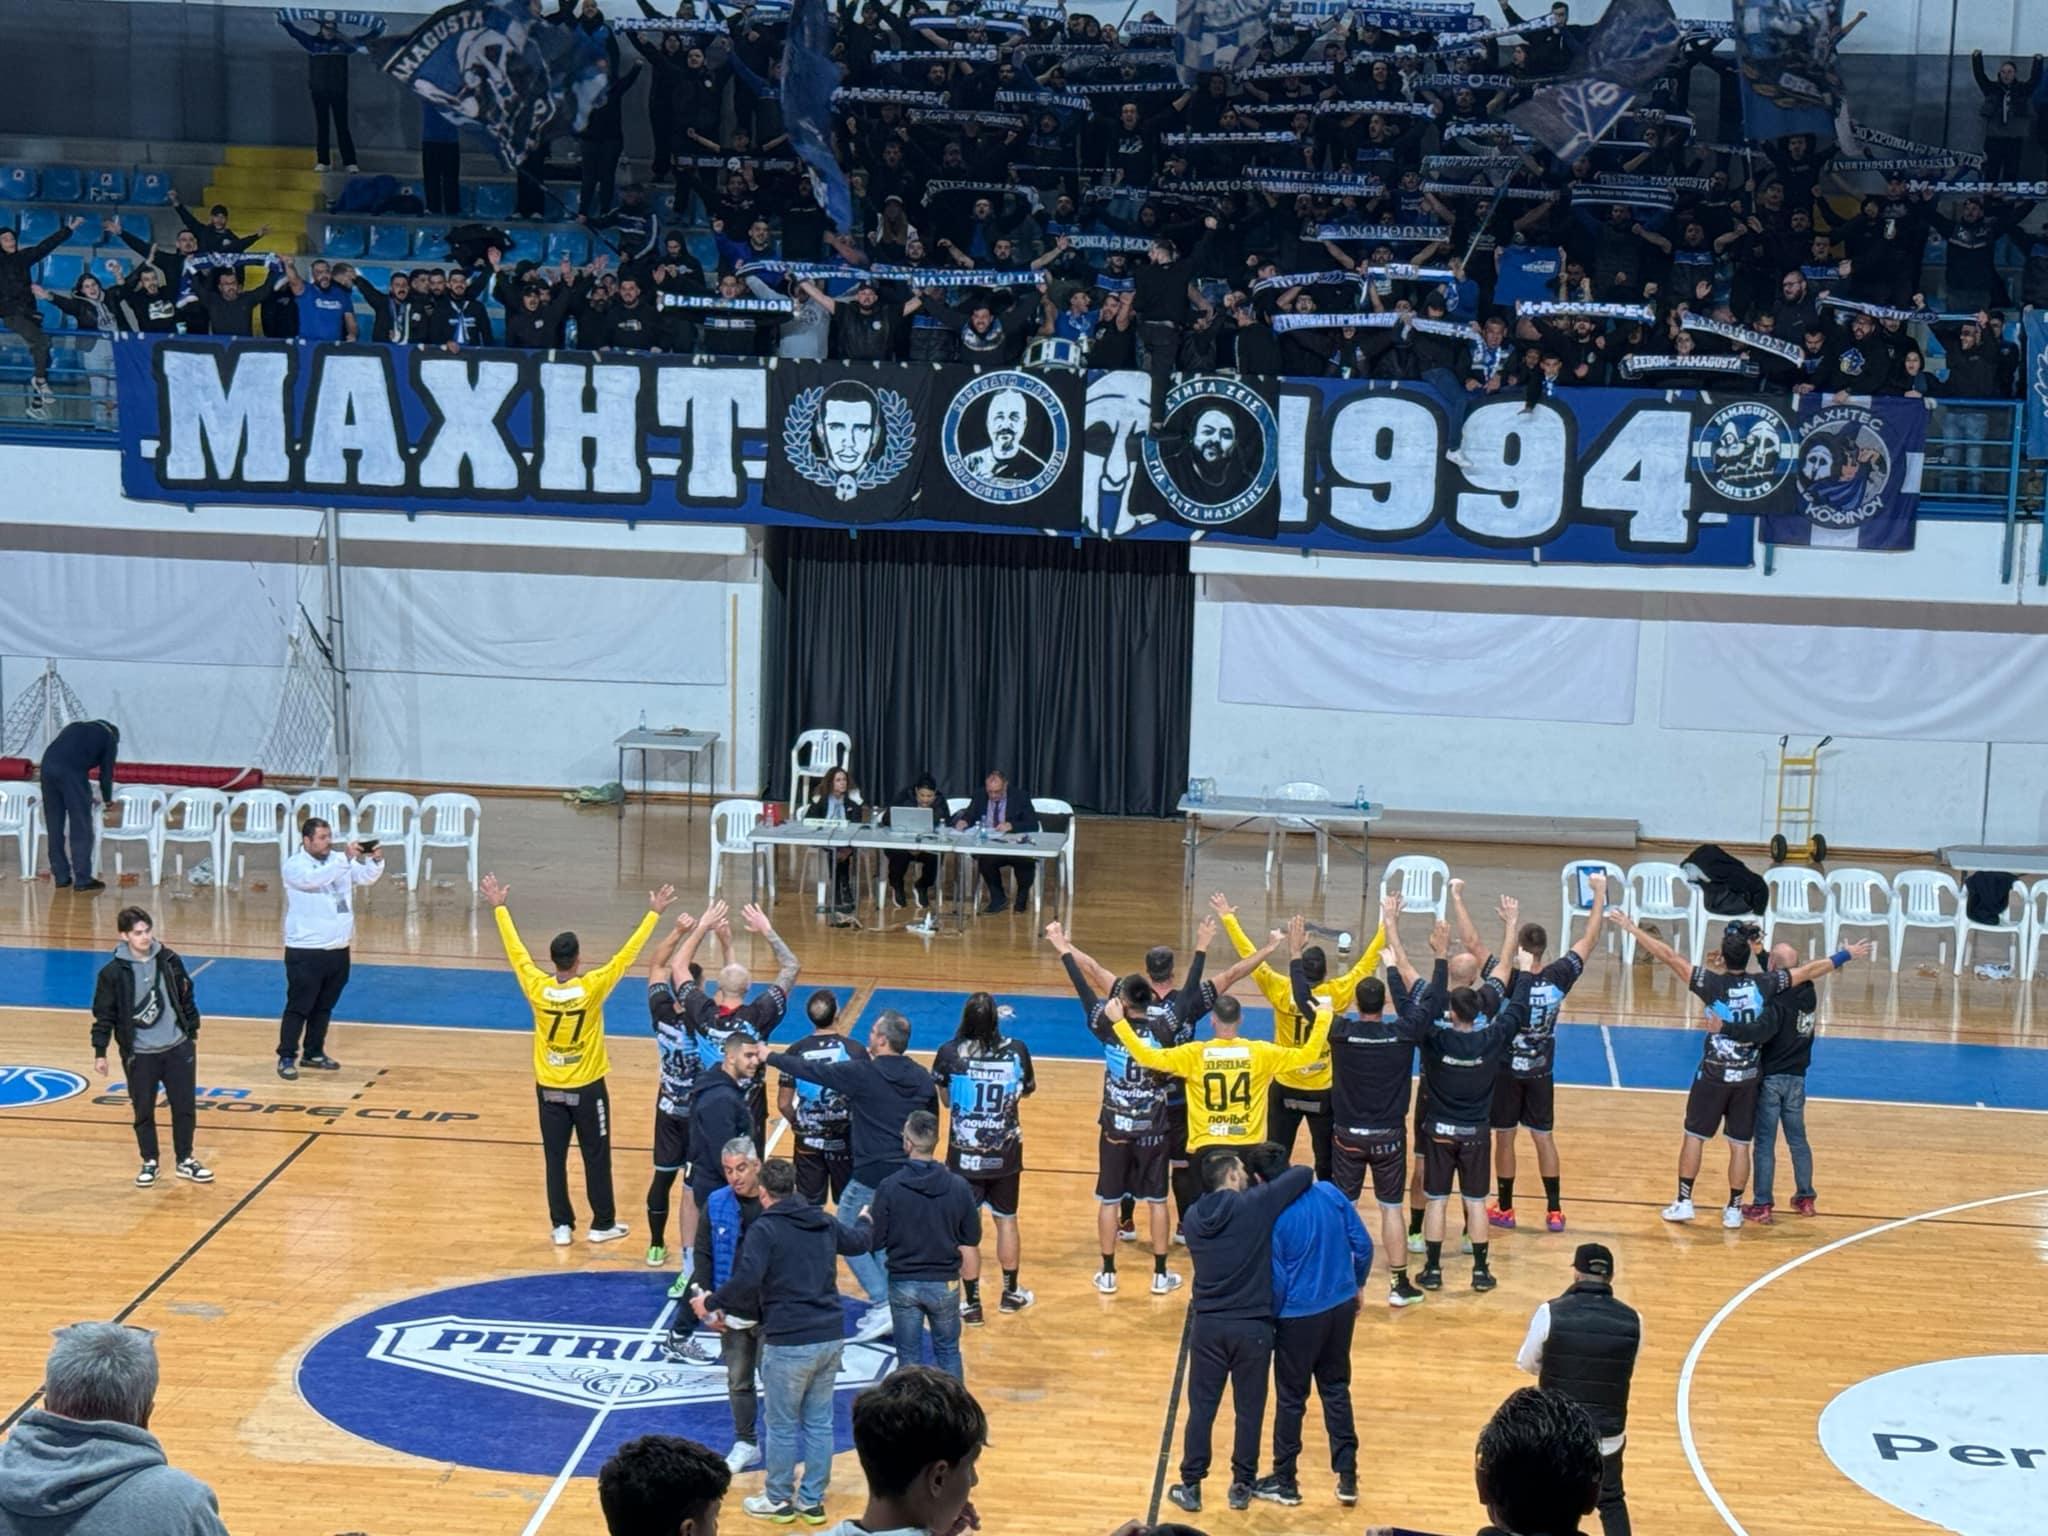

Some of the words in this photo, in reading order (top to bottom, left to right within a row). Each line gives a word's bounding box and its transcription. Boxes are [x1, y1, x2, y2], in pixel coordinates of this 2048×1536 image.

[391, 10, 485, 82] AMAGUSTA
[734, 298, 792, 312] UNION
[162, 351, 770, 498] ΜΑΧΗΤ
[1714, 404, 1780, 427] FAMAGUSTA
[1278, 395, 1693, 544] 1994
[1715, 480, 1773, 499] GHETTO
[543, 1008, 587, 1046] 77
[974, 1083, 1004, 1113] 19
[1203, 1071, 1251, 1112] 04
[92, 1095, 348, 1116] EROPE
[355, 1107, 480, 1123] CUP
[962, 1117, 1006, 1130] novibet
[1207, 1113, 1250, 1125] novibet
[1872, 1432, 2047, 1469] Per
